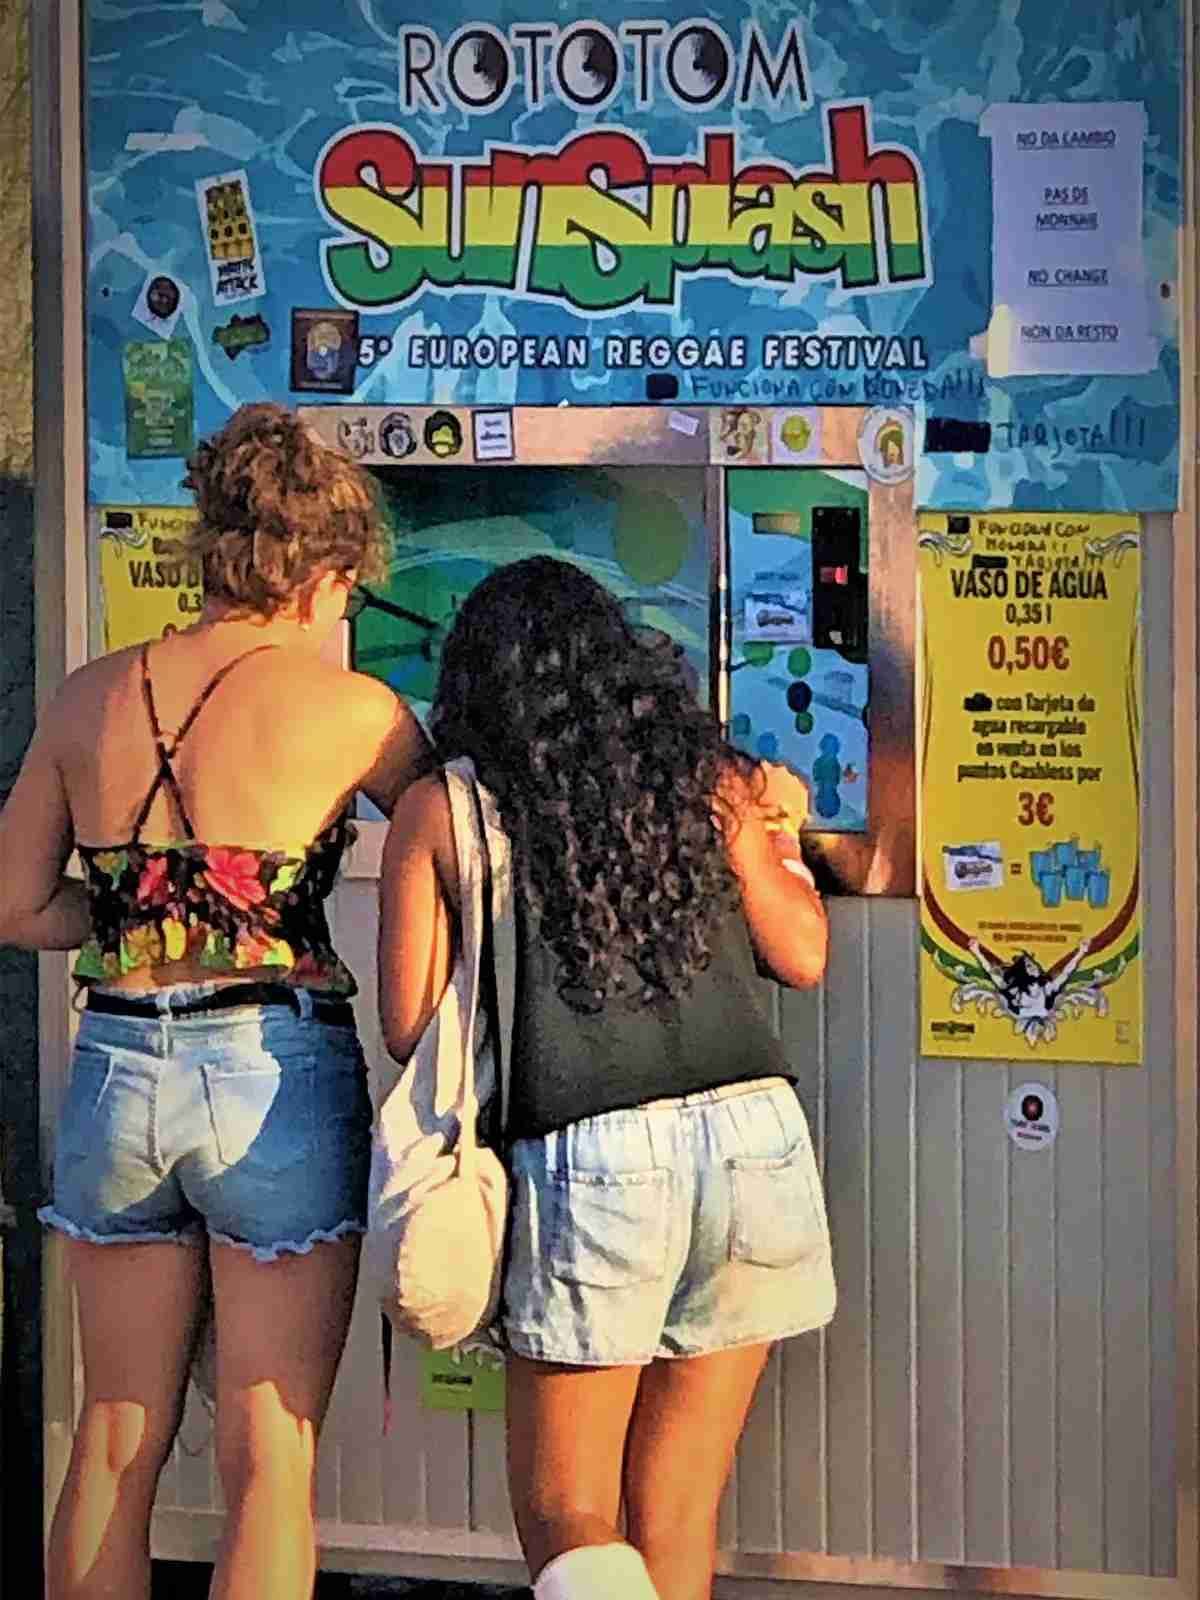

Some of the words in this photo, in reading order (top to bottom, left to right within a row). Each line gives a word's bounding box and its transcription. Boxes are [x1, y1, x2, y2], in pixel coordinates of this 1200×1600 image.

[401, 24, 810, 109] ROTOTOM
[1028, 269, 1049, 283] NO
[1054, 267, 1108, 284] CHANGE
[357, 337, 392, 367] 5º
[408, 336, 589, 368] EUROPEAN
[604, 336, 747, 369] REGGAE
[763, 336, 929, 369] FESTIVAL
[951, 568, 1009, 599] VASO
[1015, 570, 1043, 599] DE
[1048, 568, 1108, 599] AGUA
[1006, 602, 1042, 627] 0,35
[987, 634, 1071, 676] 0,50€
[1017, 791, 1055, 827] 3€
